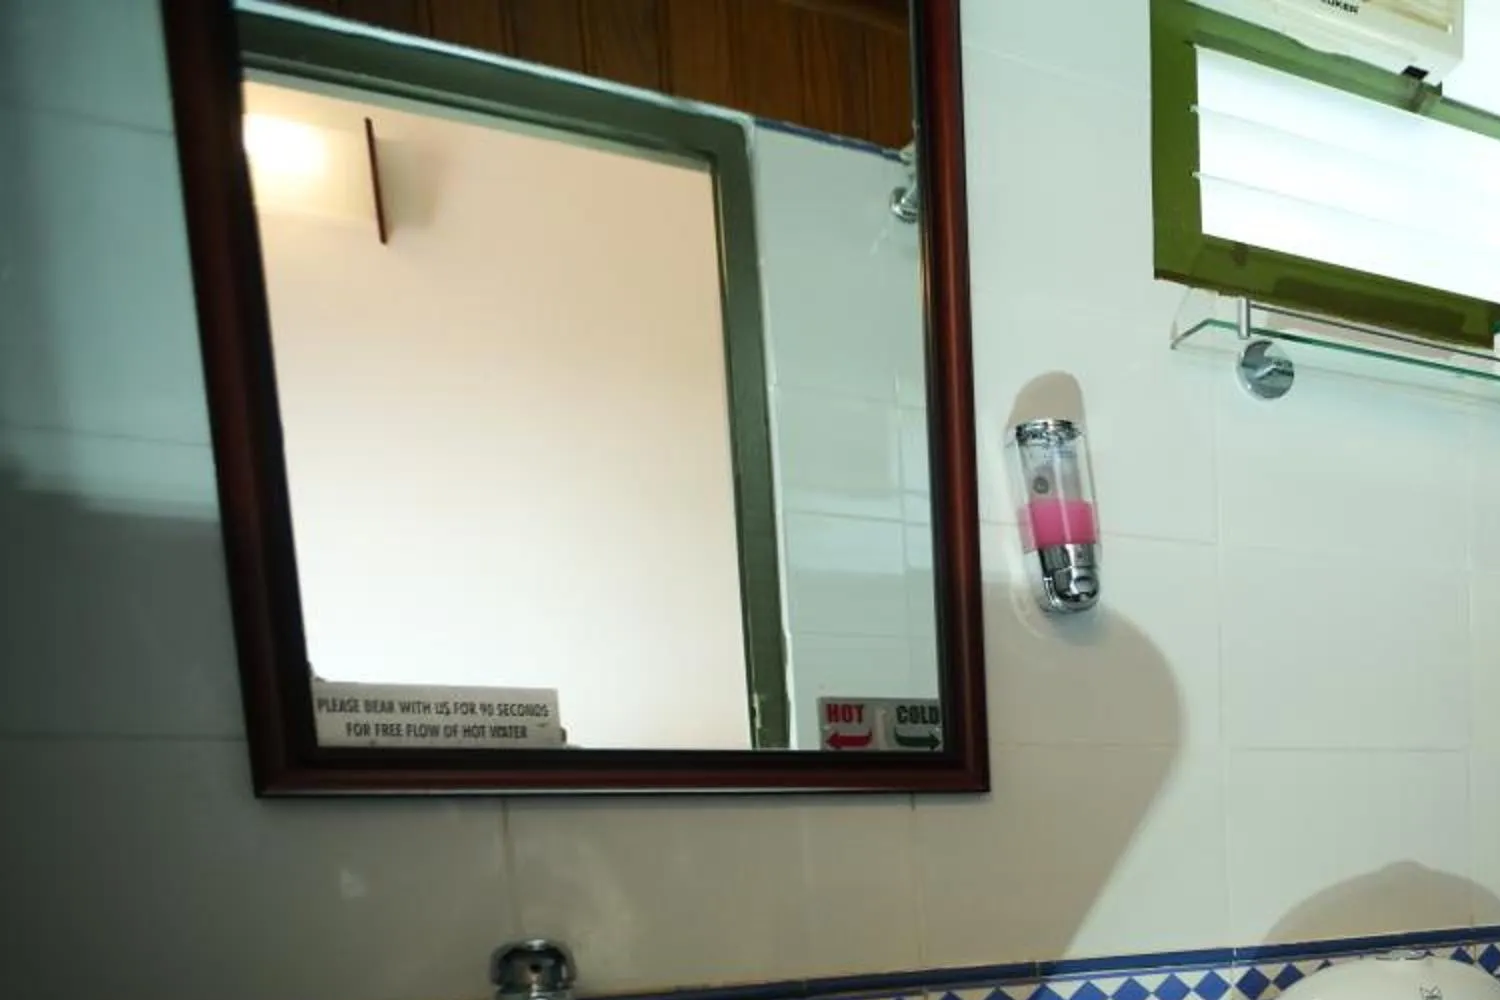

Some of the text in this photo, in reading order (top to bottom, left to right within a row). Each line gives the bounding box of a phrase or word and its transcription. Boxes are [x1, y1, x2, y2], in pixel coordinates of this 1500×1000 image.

[399, 700, 432, 714] WITH
[435, 701, 450, 716] US
[453, 702, 477, 716] FOR
[496, 703, 549, 717] SECONDS
[825, 703, 864, 724] HOT
[896, 704, 940, 725] COLD
[346, 722, 528, 739] FOR FREE FLOW OF HOT WATER
